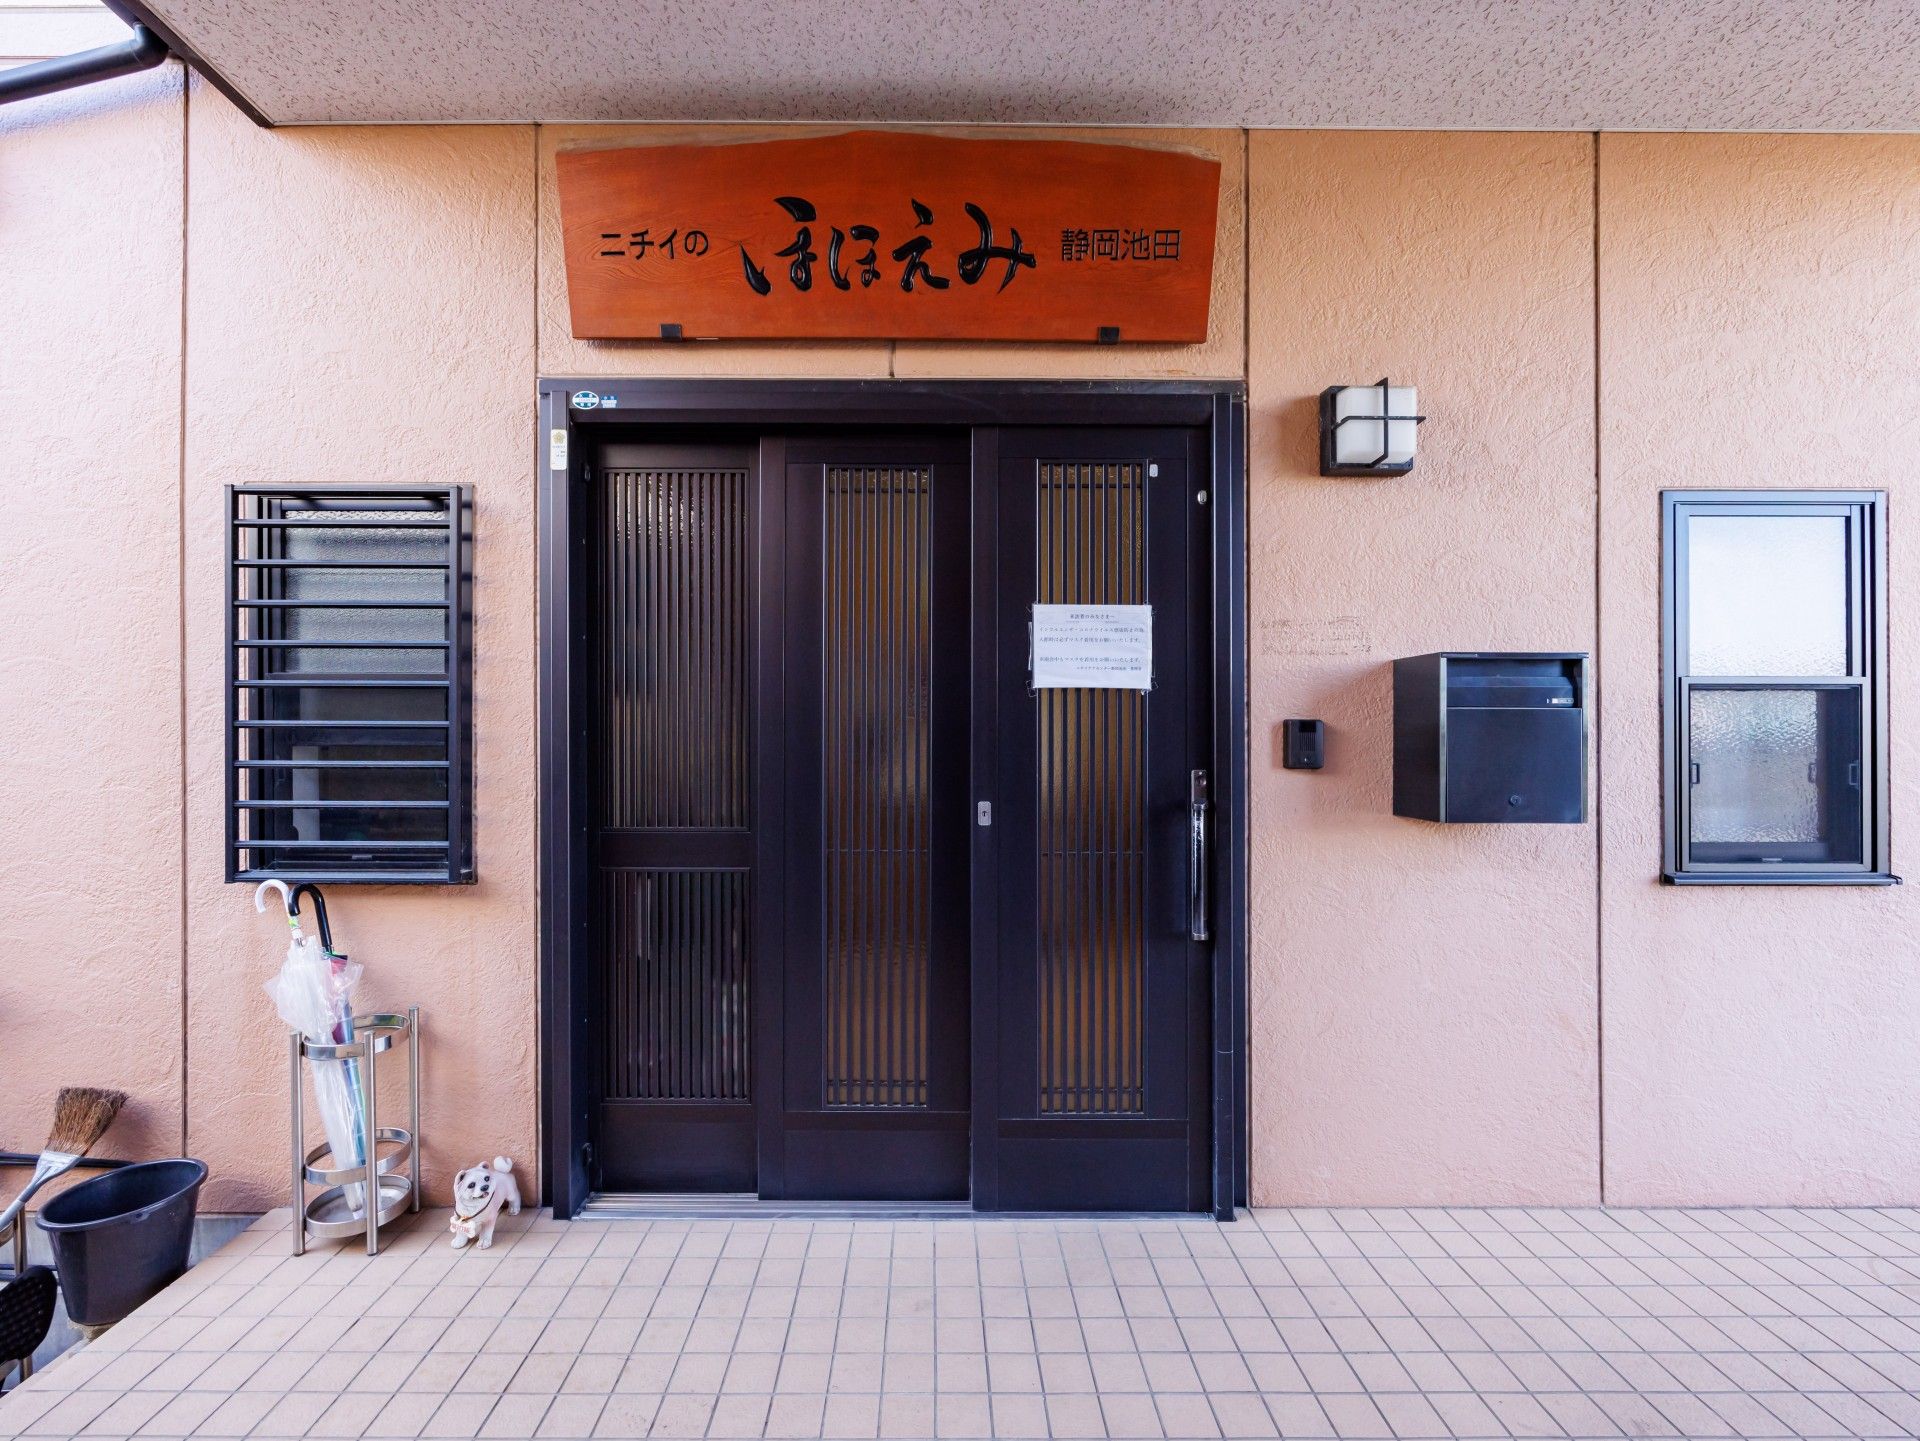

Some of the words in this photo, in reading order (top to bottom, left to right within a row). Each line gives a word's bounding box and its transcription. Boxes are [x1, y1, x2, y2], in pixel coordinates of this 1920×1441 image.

[600, 229, 709, 260] ニチイの
[740, 196, 1037, 296] ほほえみ
[1060, 228, 1181, 262] 静岡池田
